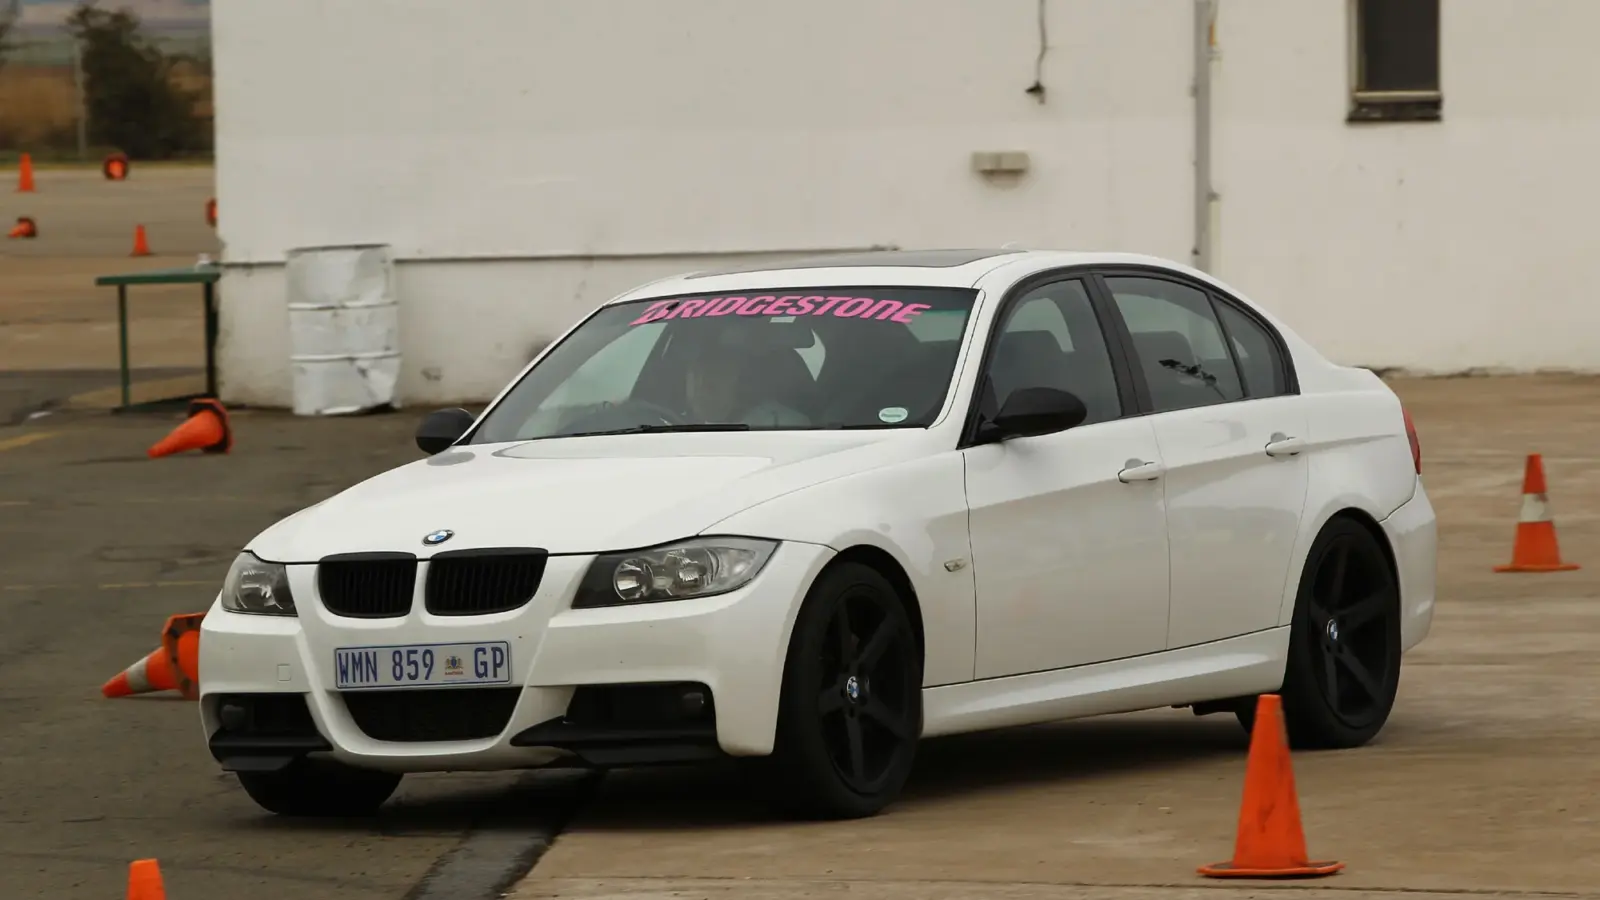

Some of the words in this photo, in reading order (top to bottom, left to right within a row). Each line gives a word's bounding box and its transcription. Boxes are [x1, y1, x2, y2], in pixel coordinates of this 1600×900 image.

[629, 295, 931, 325] BRIDGESTONE
[338, 651, 378, 683] WMN
[392, 649, 434, 681] 859
[474, 647, 504, 678] GP
